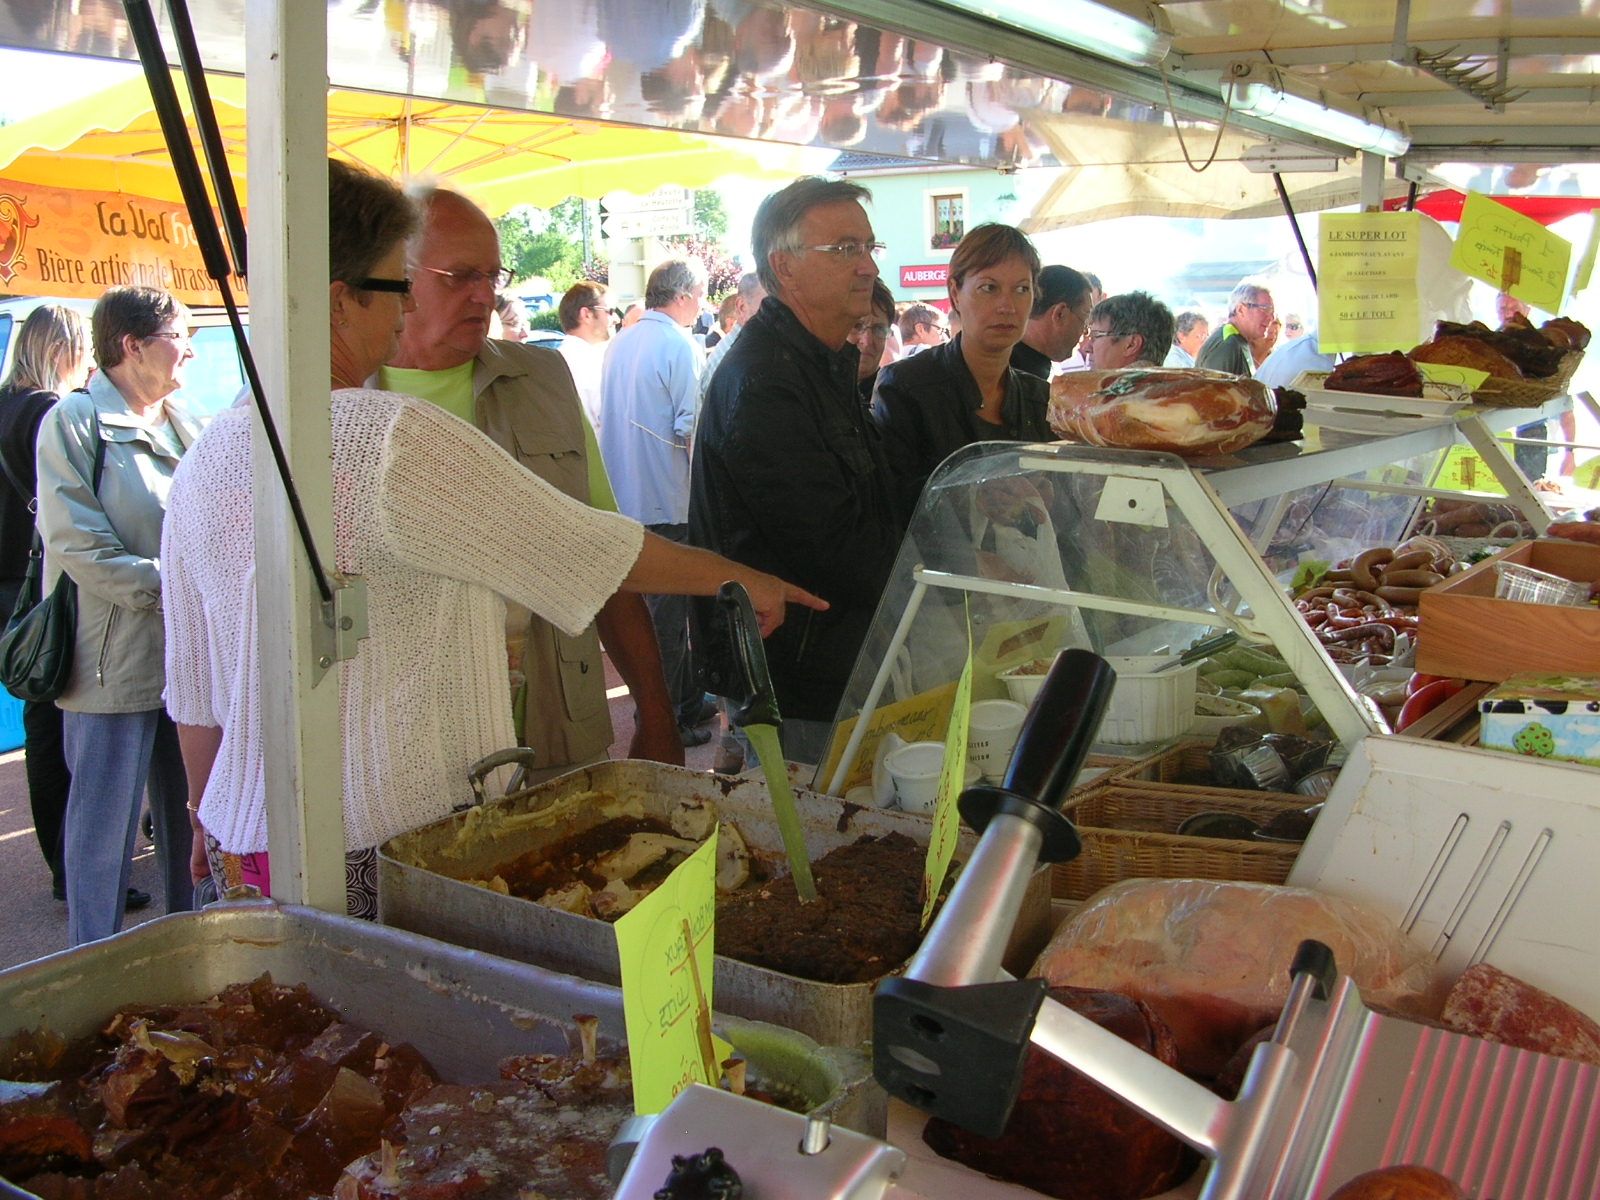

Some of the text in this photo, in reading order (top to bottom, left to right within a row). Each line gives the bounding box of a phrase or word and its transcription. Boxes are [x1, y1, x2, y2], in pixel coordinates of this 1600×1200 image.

[1328, 231, 1407, 241] LE SUPER LOT
[37, 247, 84, 285] Bière
[91, 254, 168, 291] artisanale
[903, 270, 947, 282] AUBERGE
[1356, 311, 1369, 319] LE
[1370, 310, 1396, 319] TOUT
